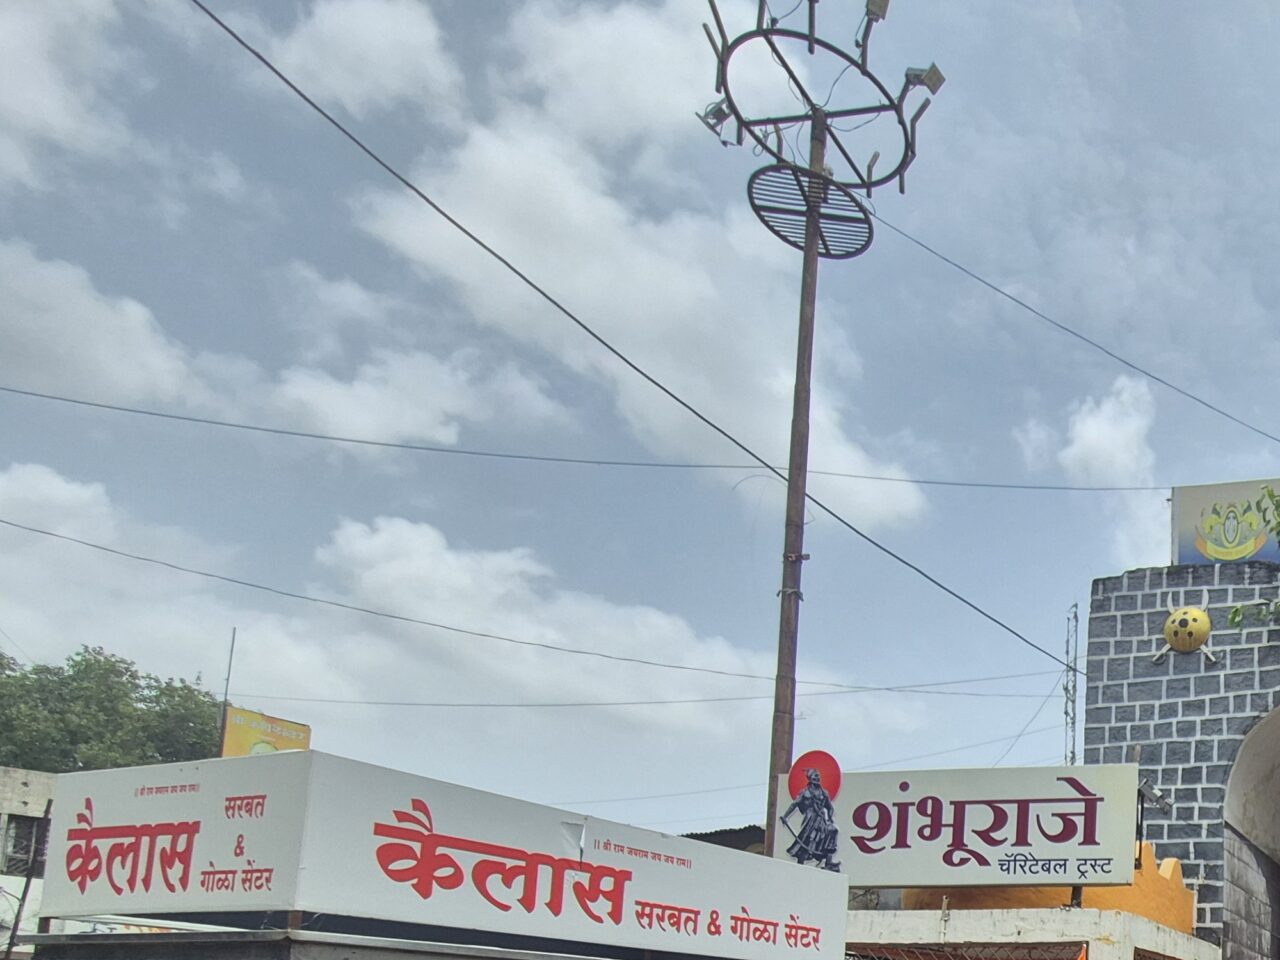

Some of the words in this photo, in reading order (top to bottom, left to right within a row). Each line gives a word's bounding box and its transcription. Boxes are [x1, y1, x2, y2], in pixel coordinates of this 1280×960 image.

[224, 794, 267, 820] सरबत
[850, 776, 1104, 868] शंभूराजे
[65, 797, 201, 896] कैलास
[233, 834, 245, 856] &
[200, 860, 236, 894] गोळा
[240, 859, 274, 893] सेंटर
[373, 797, 632, 926] कैलास
[634, 899, 701, 936] सरबत
[706, 910, 722, 935] &
[730, 905, 780, 946] गोळा
[784, 913, 822, 952] सेंटर
[998, 851, 1067, 876] चॅरिटेबल
[1076, 857, 1114, 879] ट्रस्ट
